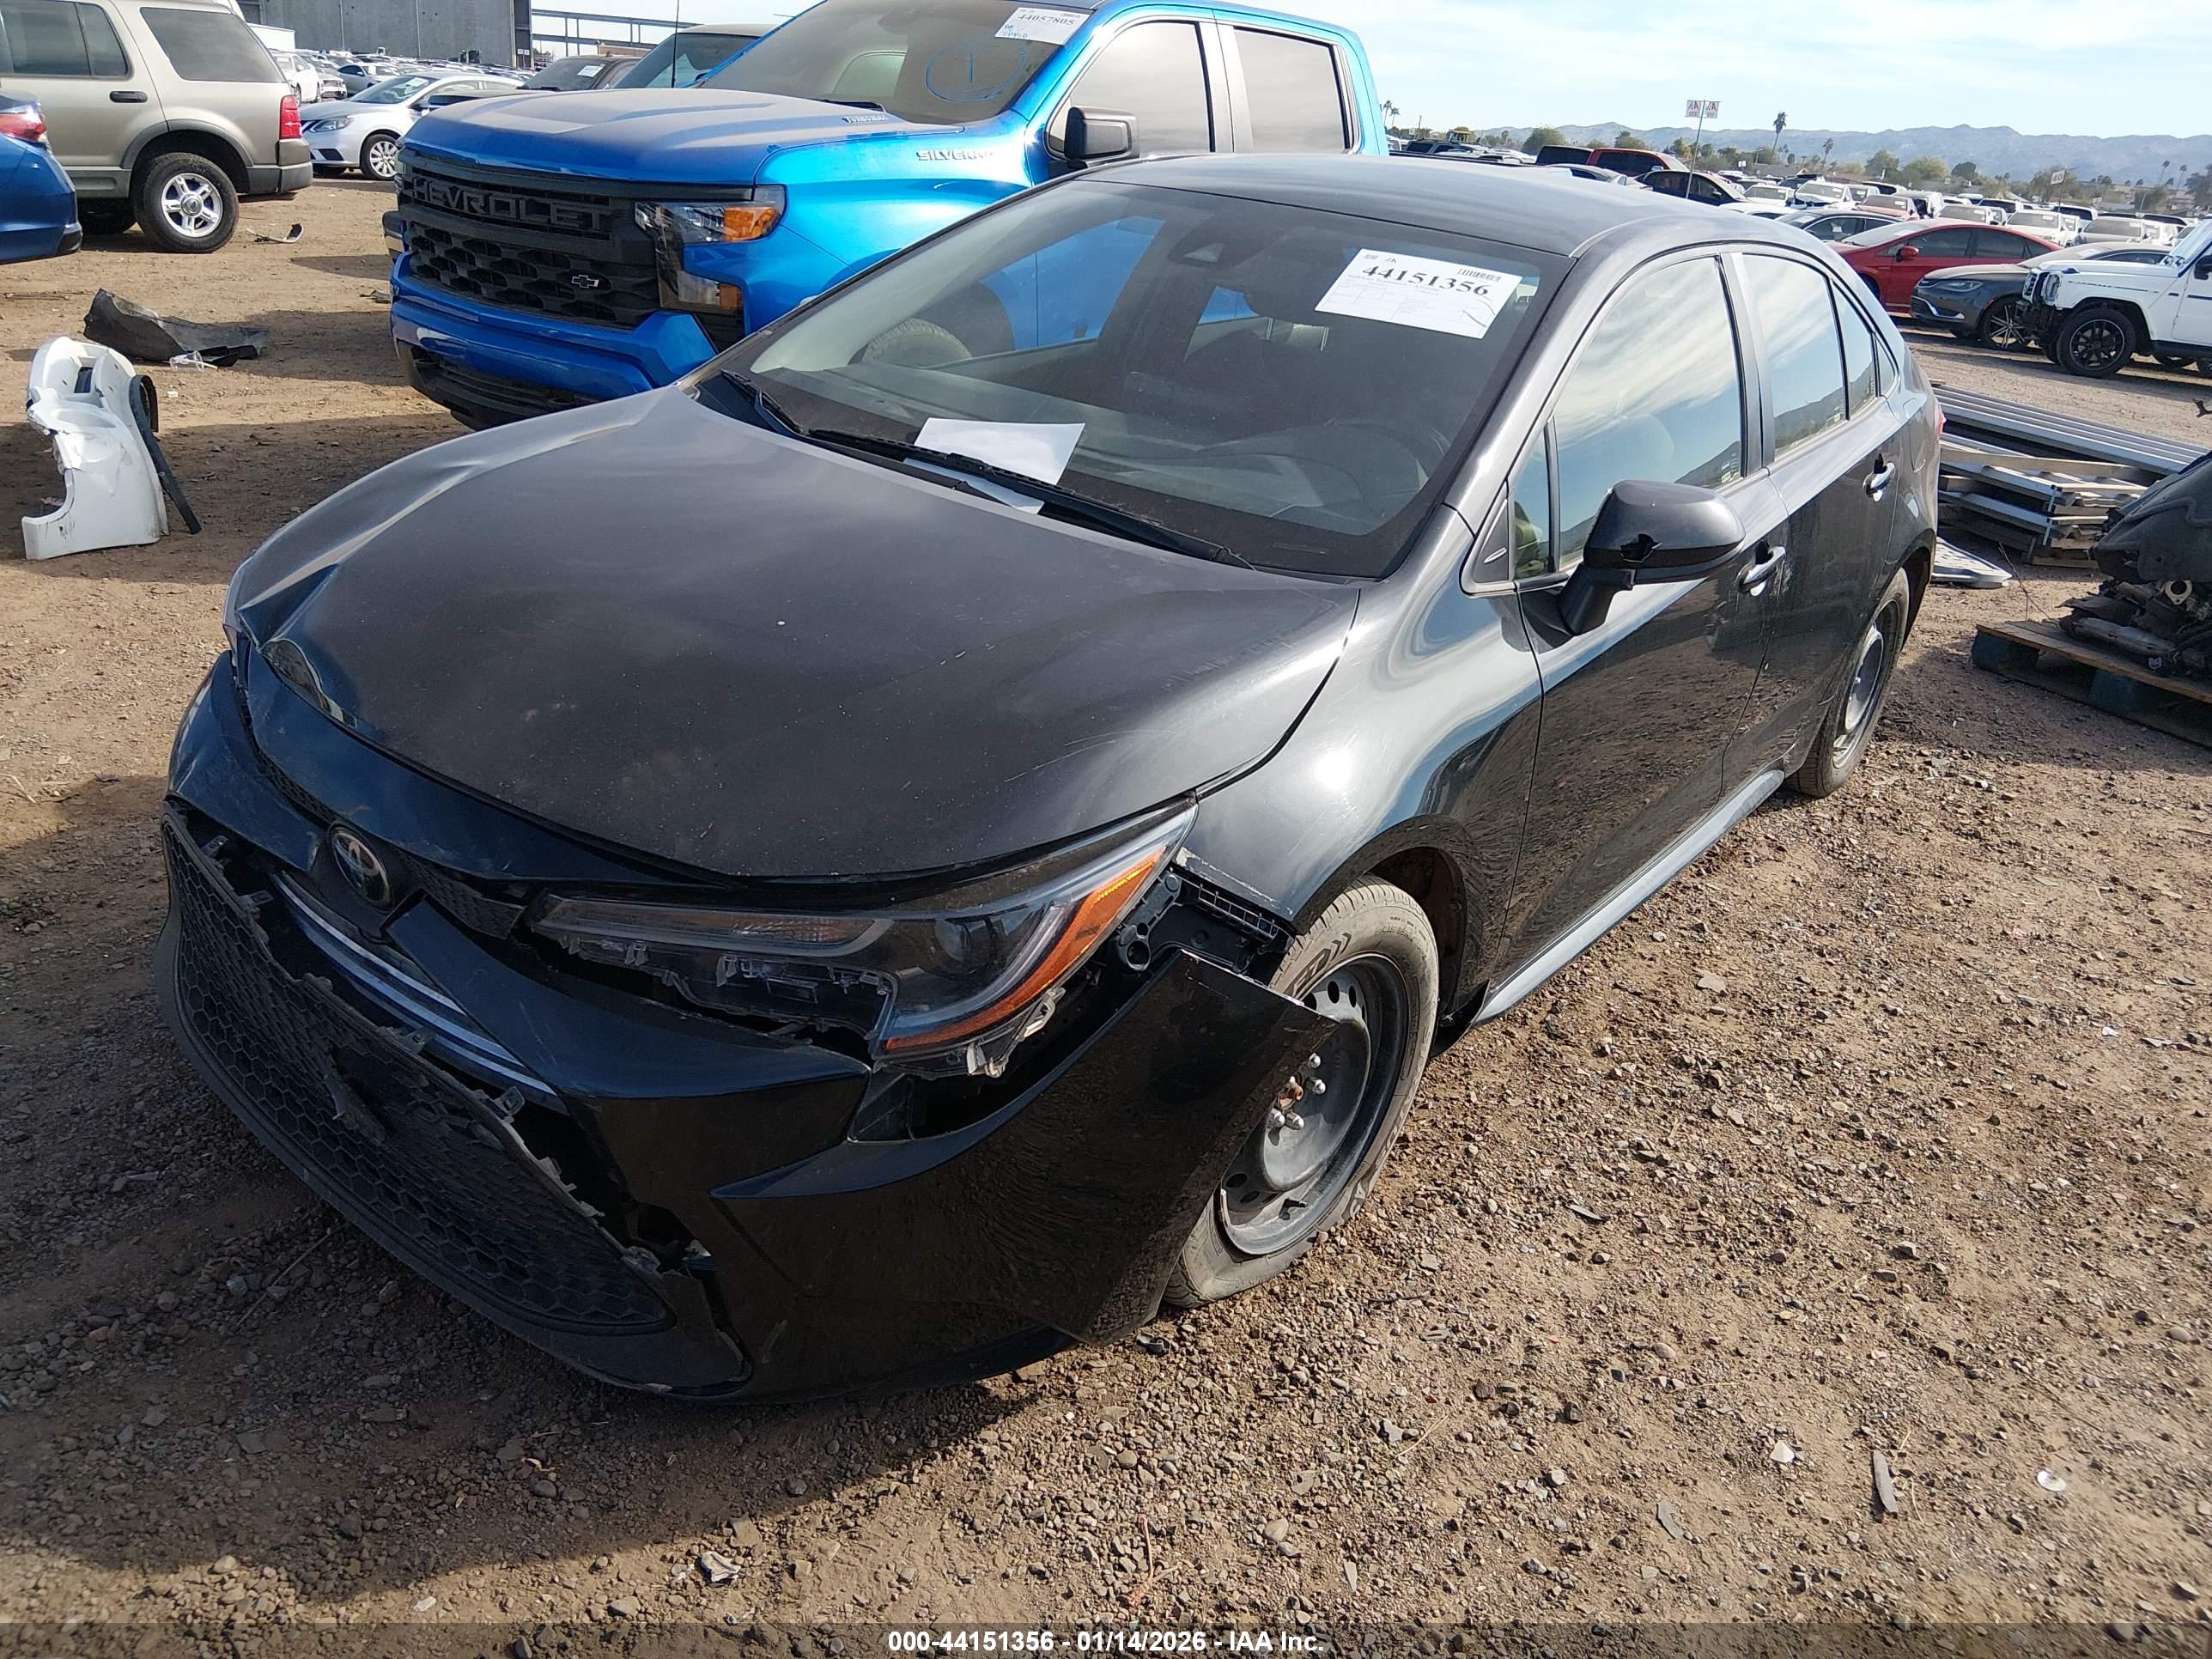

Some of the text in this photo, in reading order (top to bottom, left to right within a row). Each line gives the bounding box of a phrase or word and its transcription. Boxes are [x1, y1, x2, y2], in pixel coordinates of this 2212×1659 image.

[1018, 14, 1077, 26] 44057805
[2052, 173, 2063, 181] 40
[1362, 265, 1492, 295] 44151356
